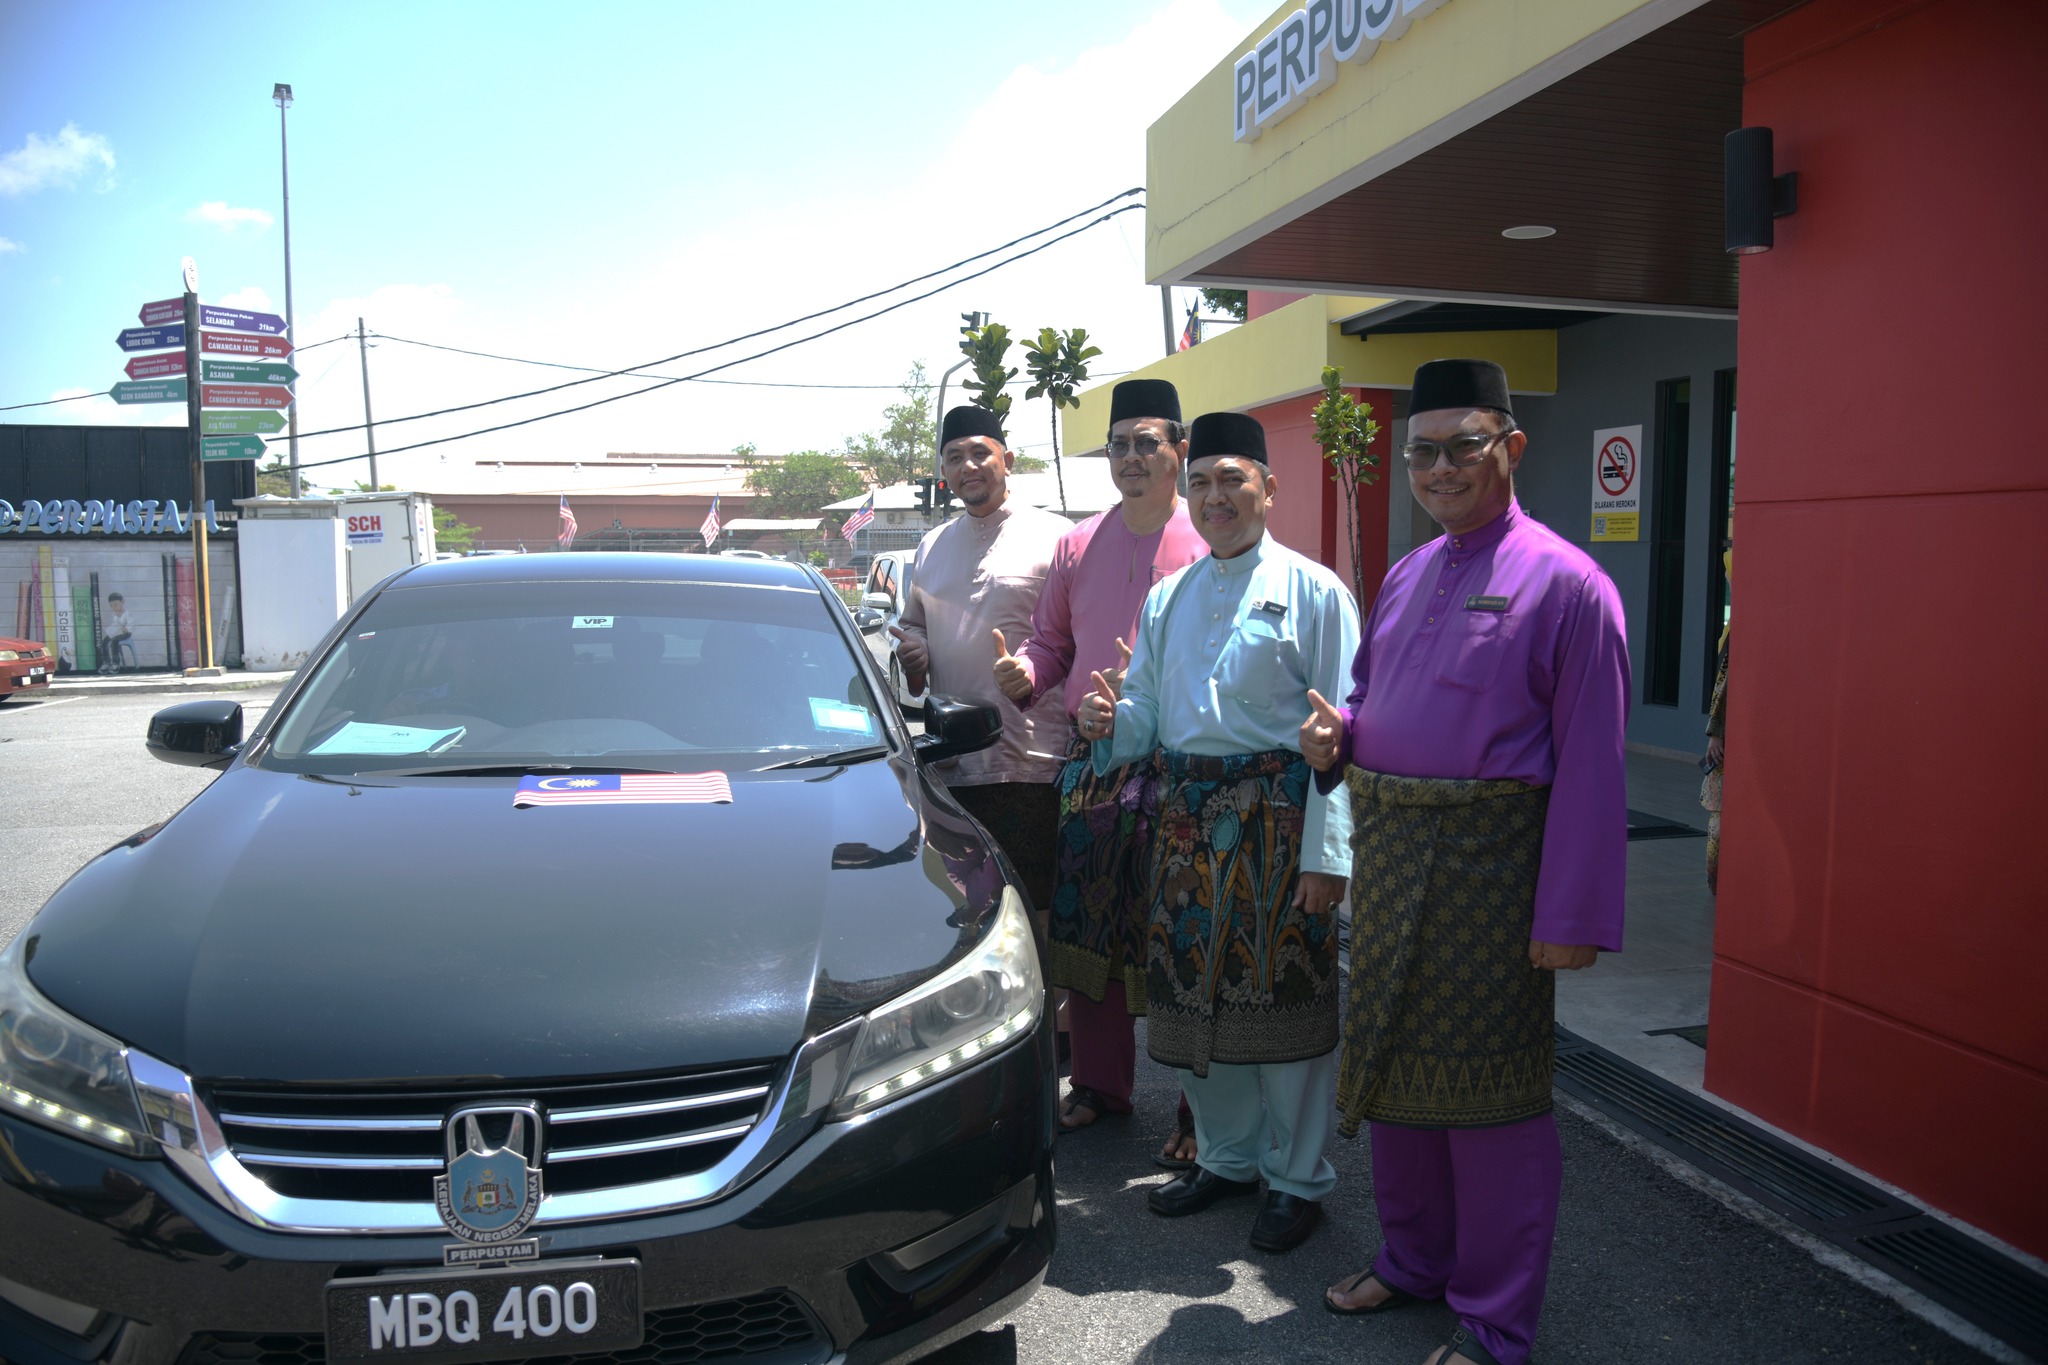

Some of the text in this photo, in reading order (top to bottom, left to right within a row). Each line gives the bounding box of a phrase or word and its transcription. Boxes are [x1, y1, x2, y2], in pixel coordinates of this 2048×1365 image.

[206, 317, 234, 326] SELANDAR
[208, 343, 241, 351] CAWANGAN
[348, 516, 381, 532] SCH
[59, 611, 69, 642] BIRDS
[438, 1175, 537, 1242] KERAJAAN NEGERI MELAKA
[451, 1245, 532, 1260] PERPUSTAM
[369, 1282, 597, 1350] MBQ 400
